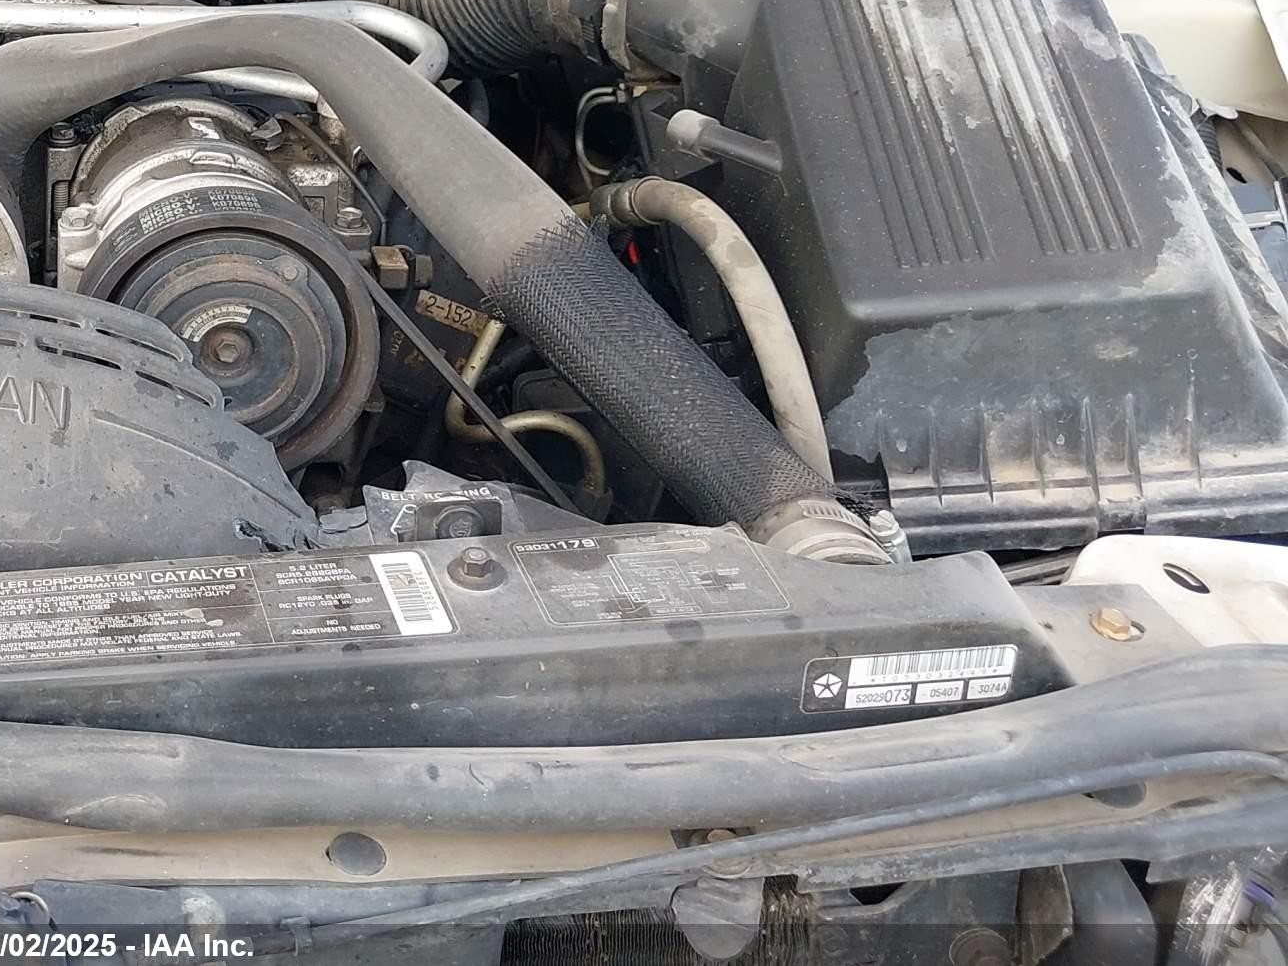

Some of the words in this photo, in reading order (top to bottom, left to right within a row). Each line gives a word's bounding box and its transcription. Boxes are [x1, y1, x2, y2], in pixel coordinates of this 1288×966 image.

[425, 296, 472, 328] 2-152
[380, 491, 416, 501] BELT
[515, 538, 596, 552] 53031179
[309, 562, 337, 570] LITER
[32, 572, 143, 587] CORPORATION
[151, 566, 247, 583] CATALYST
[14, 585, 58, 594] VEHICLE
[61, 581, 136, 591] INFORMATION
[0, 597, 42, 605] VEHICLE
[44, 593, 102, 602] CONFORMS
[166, 584, 237, 594] REGULATIONS
[149, 593, 172, 601] NEW
[175, 590, 231, 599] LIGHT-DUTY
[296, 594, 324, 602] SPARK
[57, 604, 111, 612] ALTITUDES
[291, 626, 348, 635] ADJUSTMENTS
[350, 623, 382, 632] NEEDED
[856, 687, 911, 703] 52029073
[930, 687, 959, 698] 05407
[978, 682, 1007, 694] 3074A
